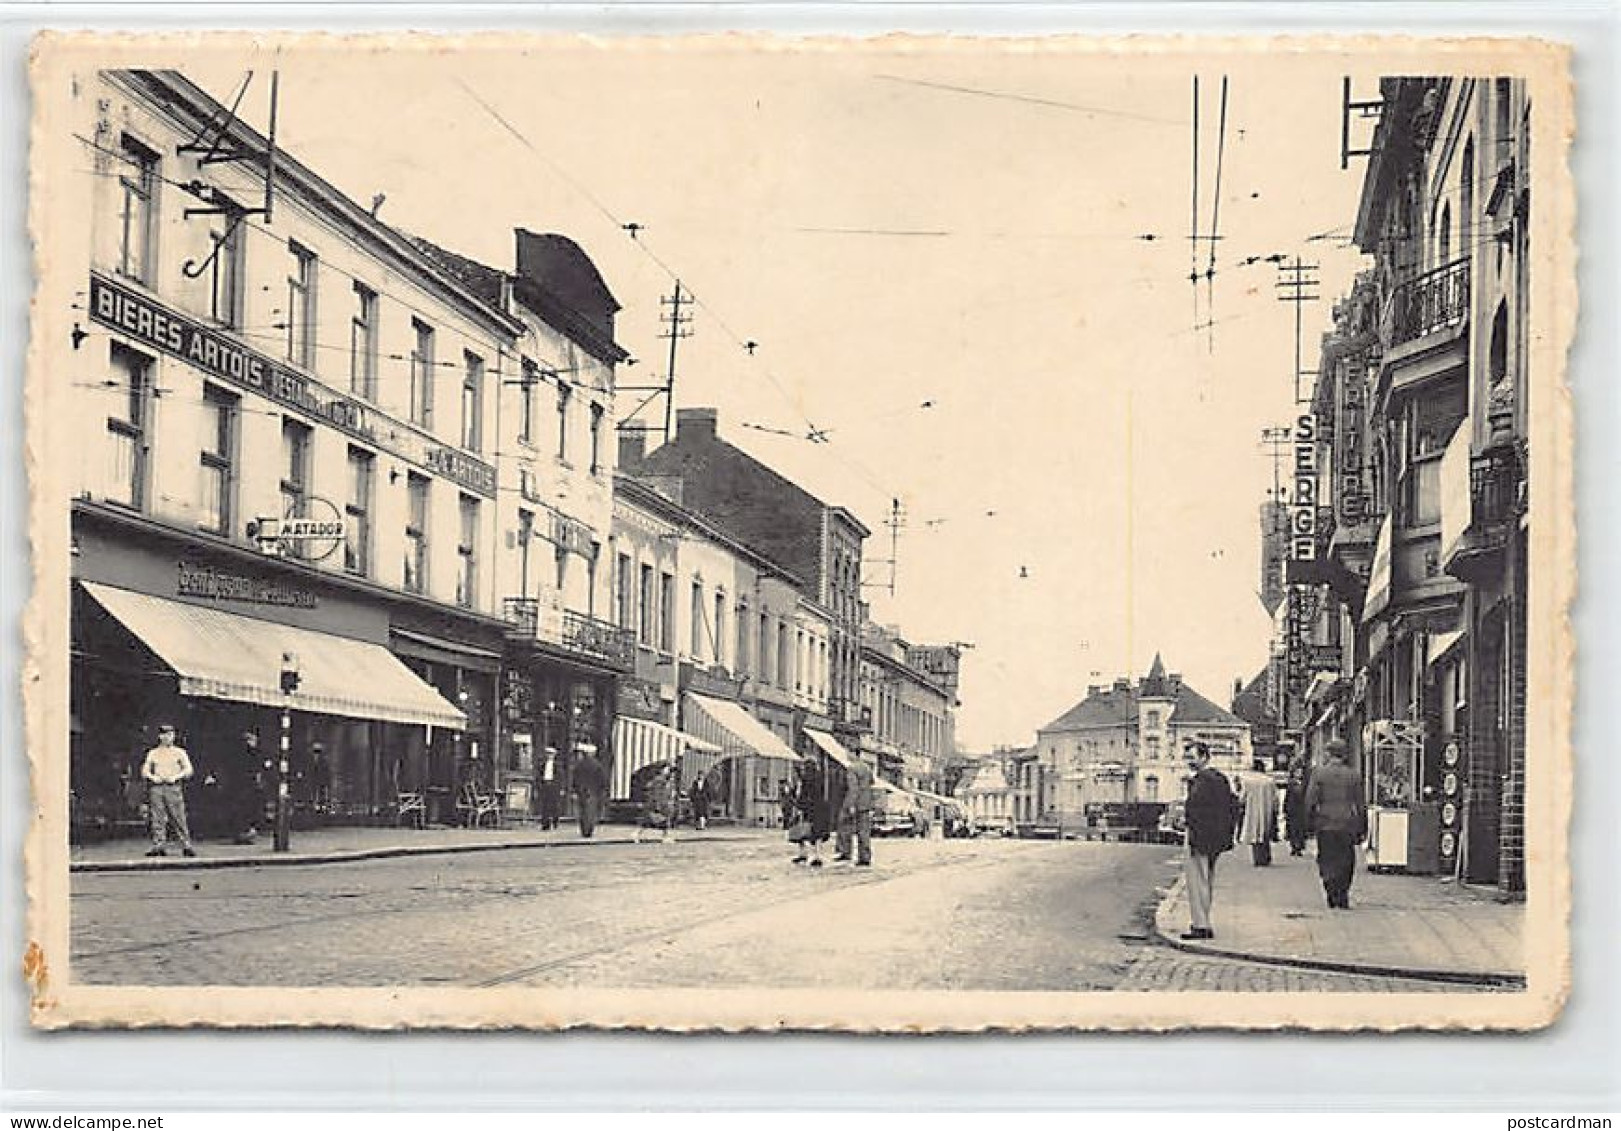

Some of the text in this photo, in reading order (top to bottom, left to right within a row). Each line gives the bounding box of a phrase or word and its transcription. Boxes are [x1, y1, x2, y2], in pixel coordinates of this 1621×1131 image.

[98, 286, 264, 386] BIERES ARTOIS
[281, 522, 343, 535] MATADOR
[1296, 414, 1315, 560] SERGE
